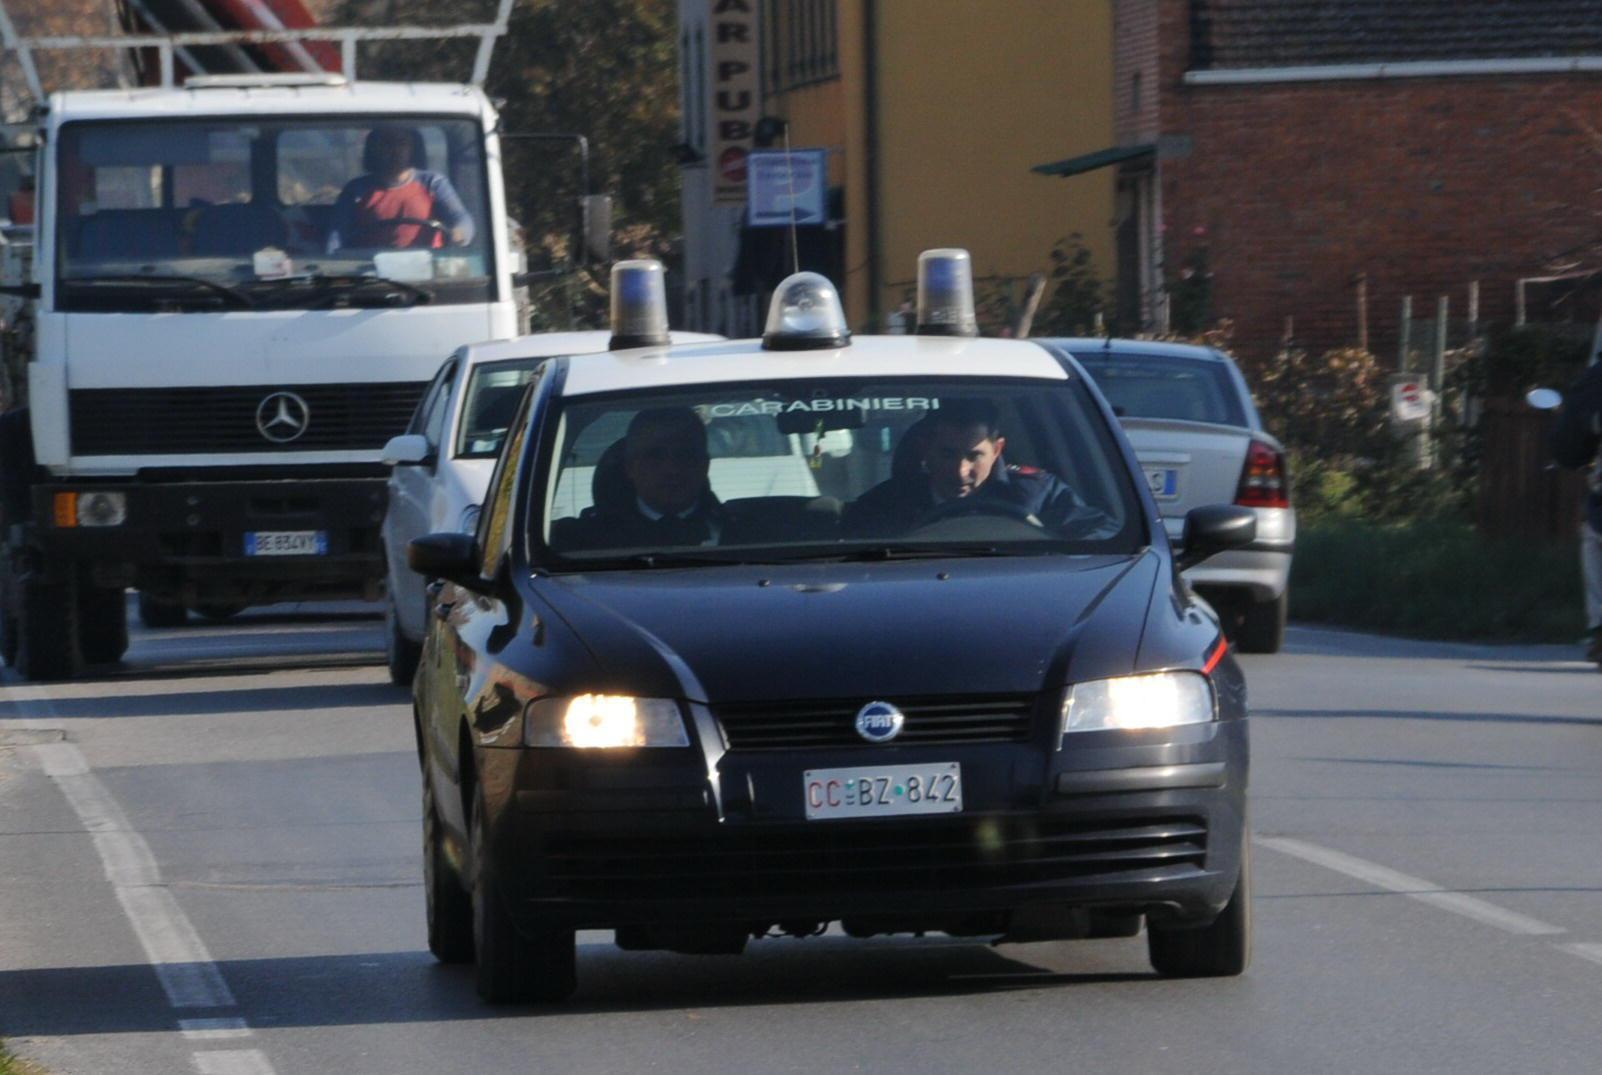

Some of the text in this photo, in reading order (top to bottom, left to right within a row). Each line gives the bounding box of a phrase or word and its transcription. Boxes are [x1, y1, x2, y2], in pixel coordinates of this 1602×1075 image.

[717, 61, 751, 140] PUB
[710, 397, 940, 417] CARABINIERI
[808, 774, 958, 808] CC BZ 842
